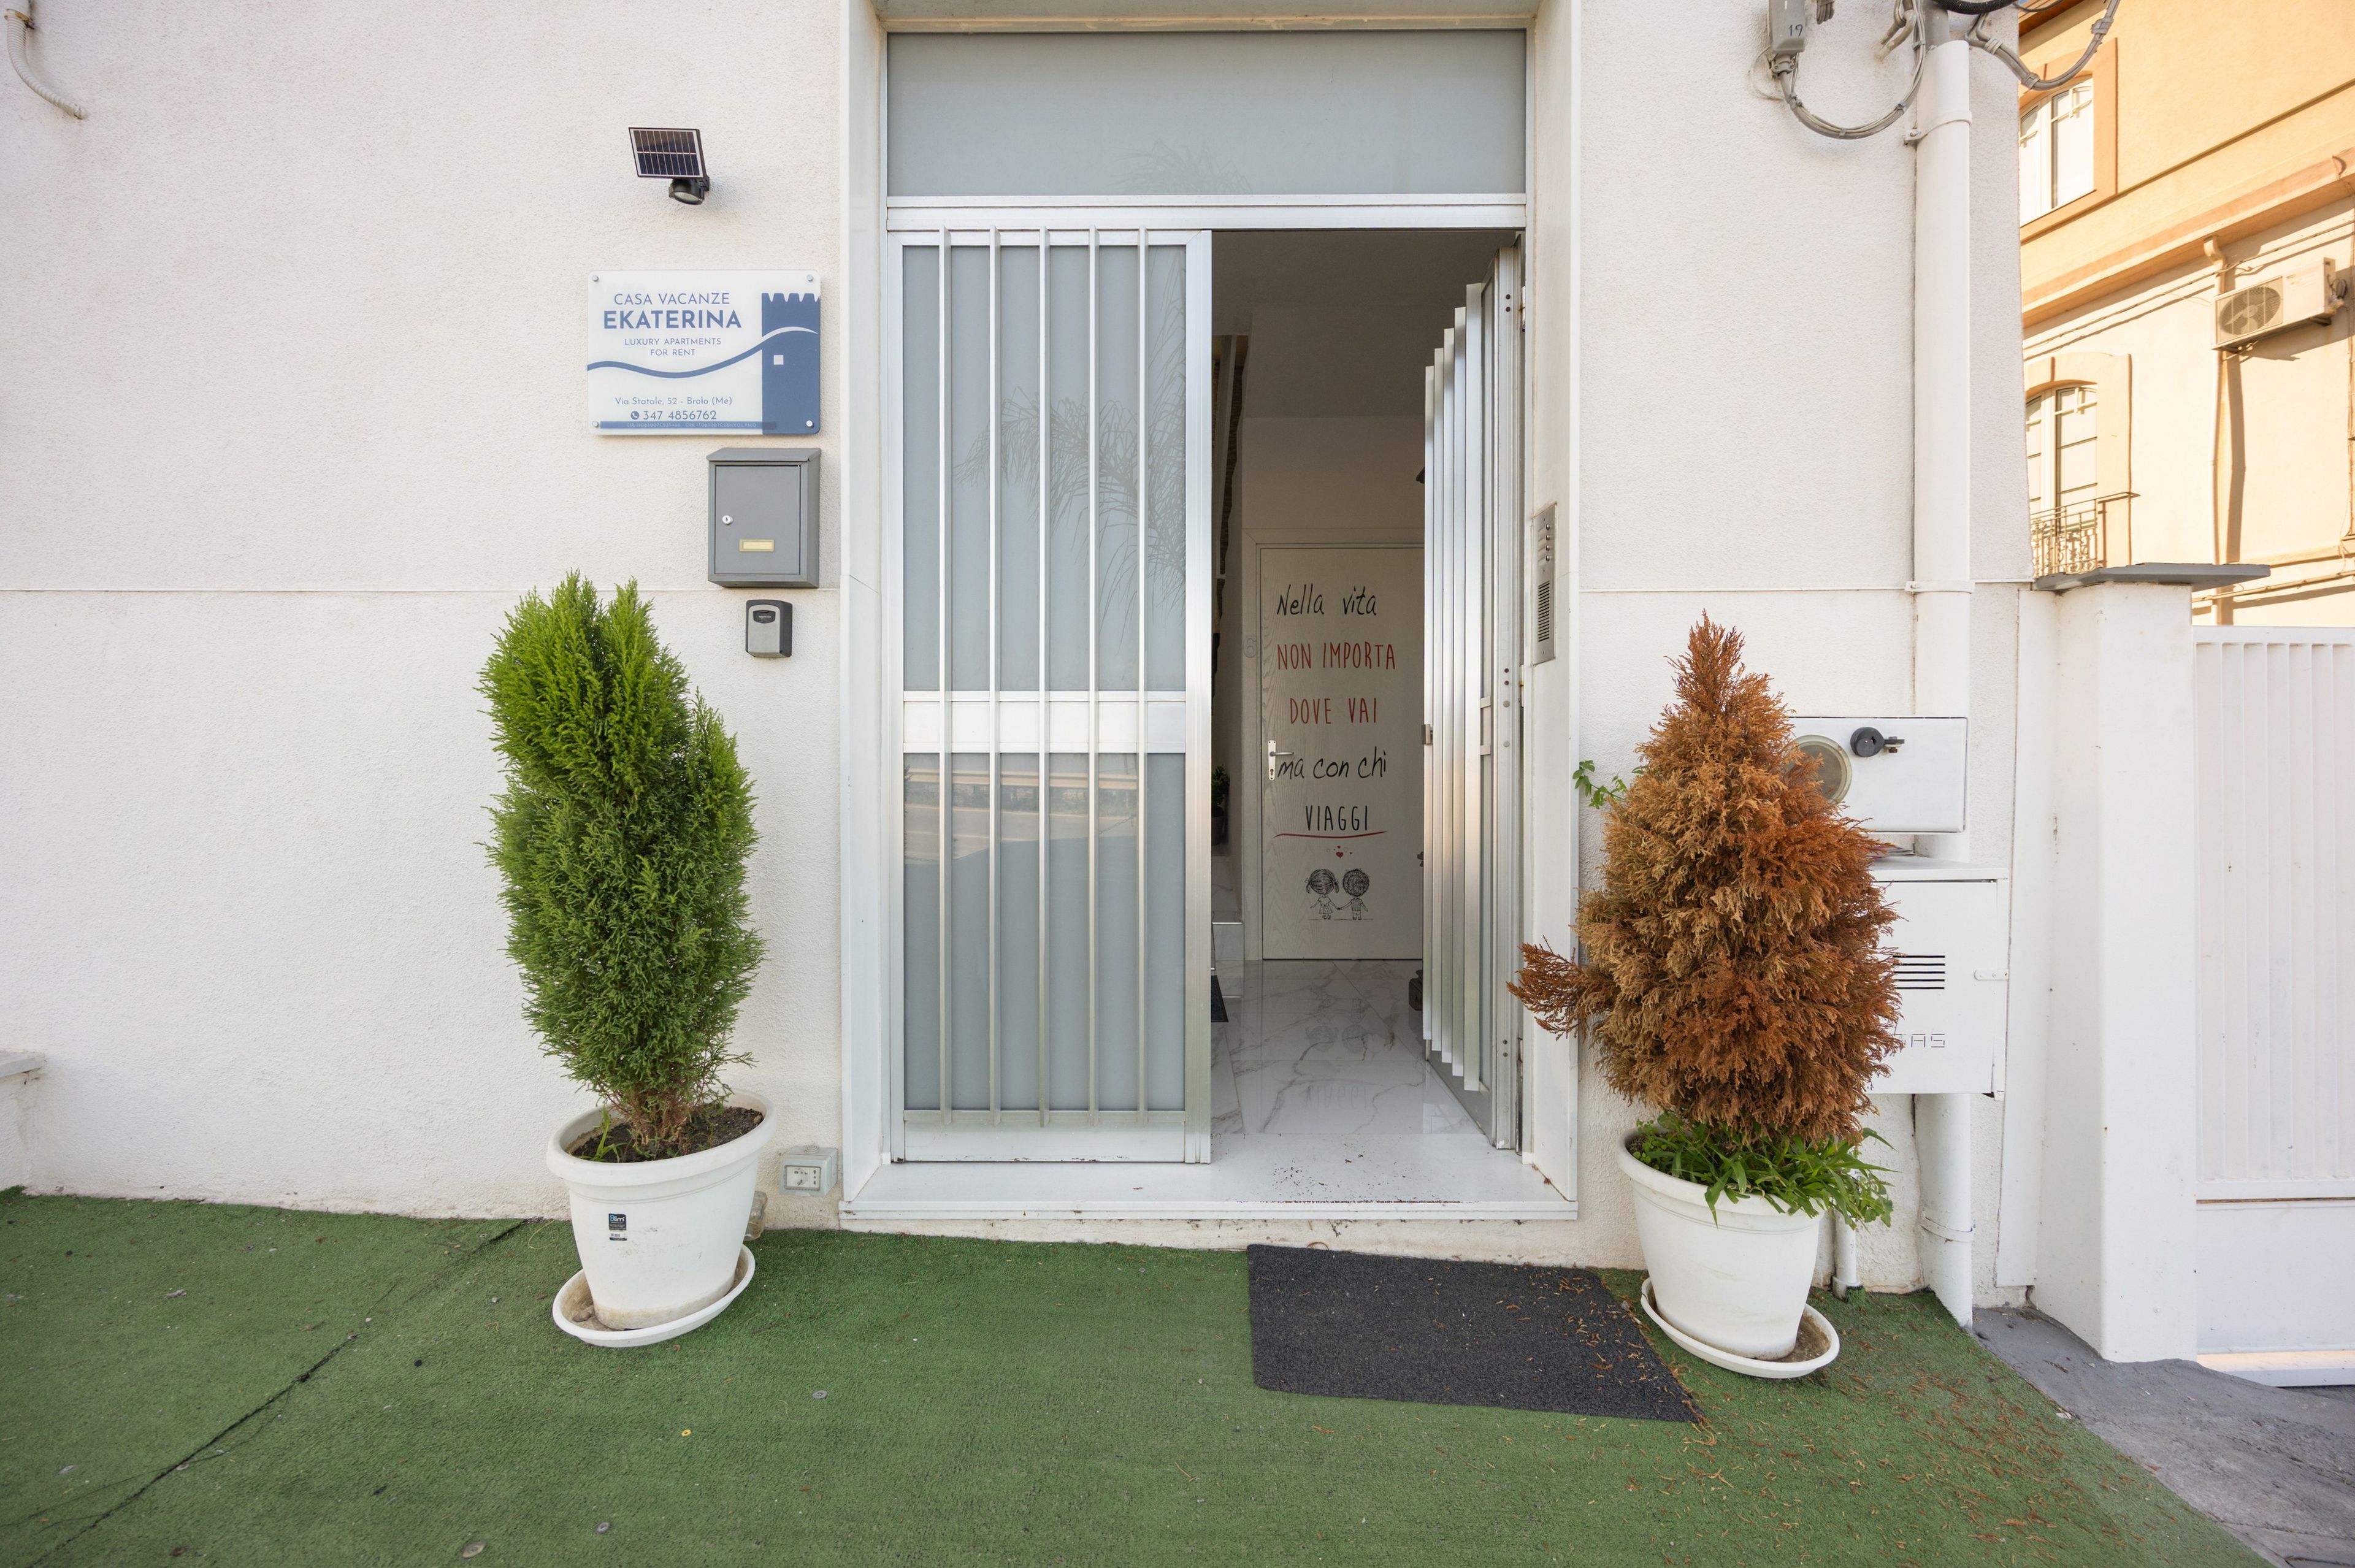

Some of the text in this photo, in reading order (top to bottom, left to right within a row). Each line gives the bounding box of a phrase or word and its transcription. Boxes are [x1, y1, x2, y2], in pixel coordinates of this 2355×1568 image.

[1788, 23, 1804, 37] 19
[614, 292, 730, 305] CASA VACANZE
[603, 309, 742, 329] EKATERINA
[615, 397, 629, 405] Via
[632, 396, 665, 407] Statale,
[687, 396, 709, 405] Brolo
[711, 396, 733, 406] (Me)
[643, 410, 718, 421] 347 4856762
[1276, 583, 1377, 616] Nella vita
[1277, 641, 1395, 670] NON IMPORTA
[1290, 697, 1377, 724] DOVE VAI
[1277, 746, 1387, 779] ma con chi
[1305, 805, 1368, 831] VIAGGI
